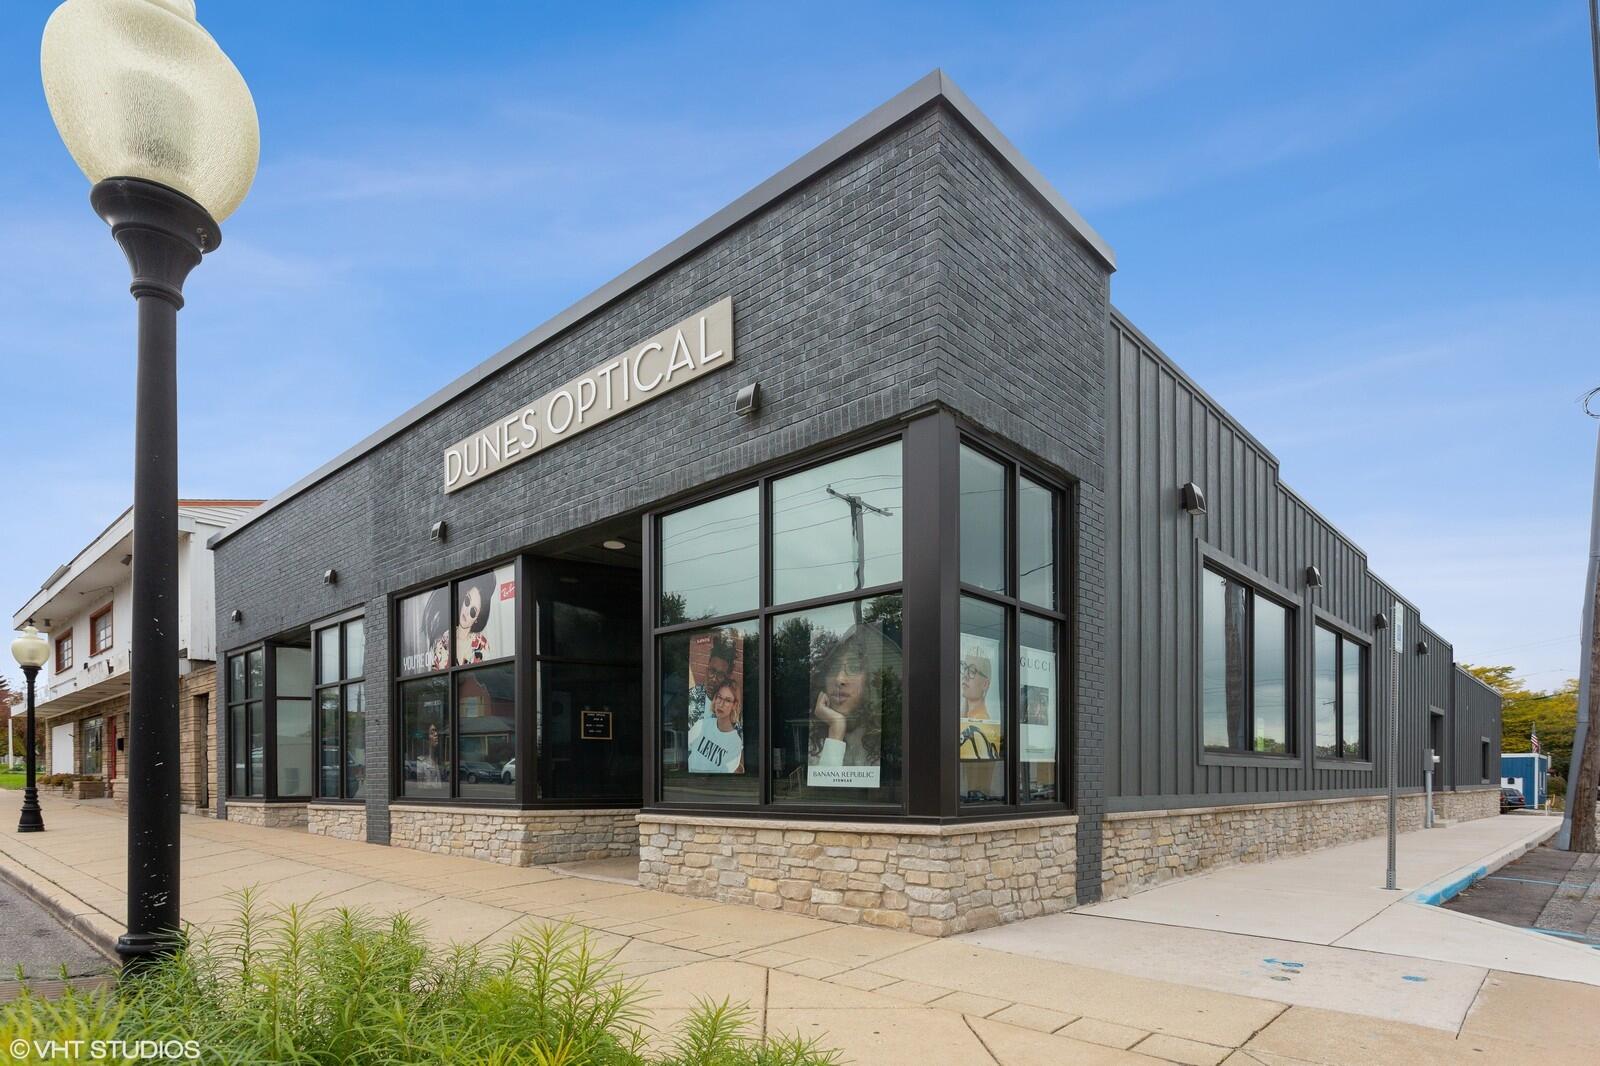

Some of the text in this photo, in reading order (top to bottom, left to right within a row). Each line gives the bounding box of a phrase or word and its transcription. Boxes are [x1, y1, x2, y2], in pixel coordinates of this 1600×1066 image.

[445, 316, 723, 487] DUNES OPTICAL
[1020, 656, 1051, 673] GUCCI
[697, 736, 727, 767] LEVI'S
[813, 770, 874, 779] BANANA REPUBLIC
